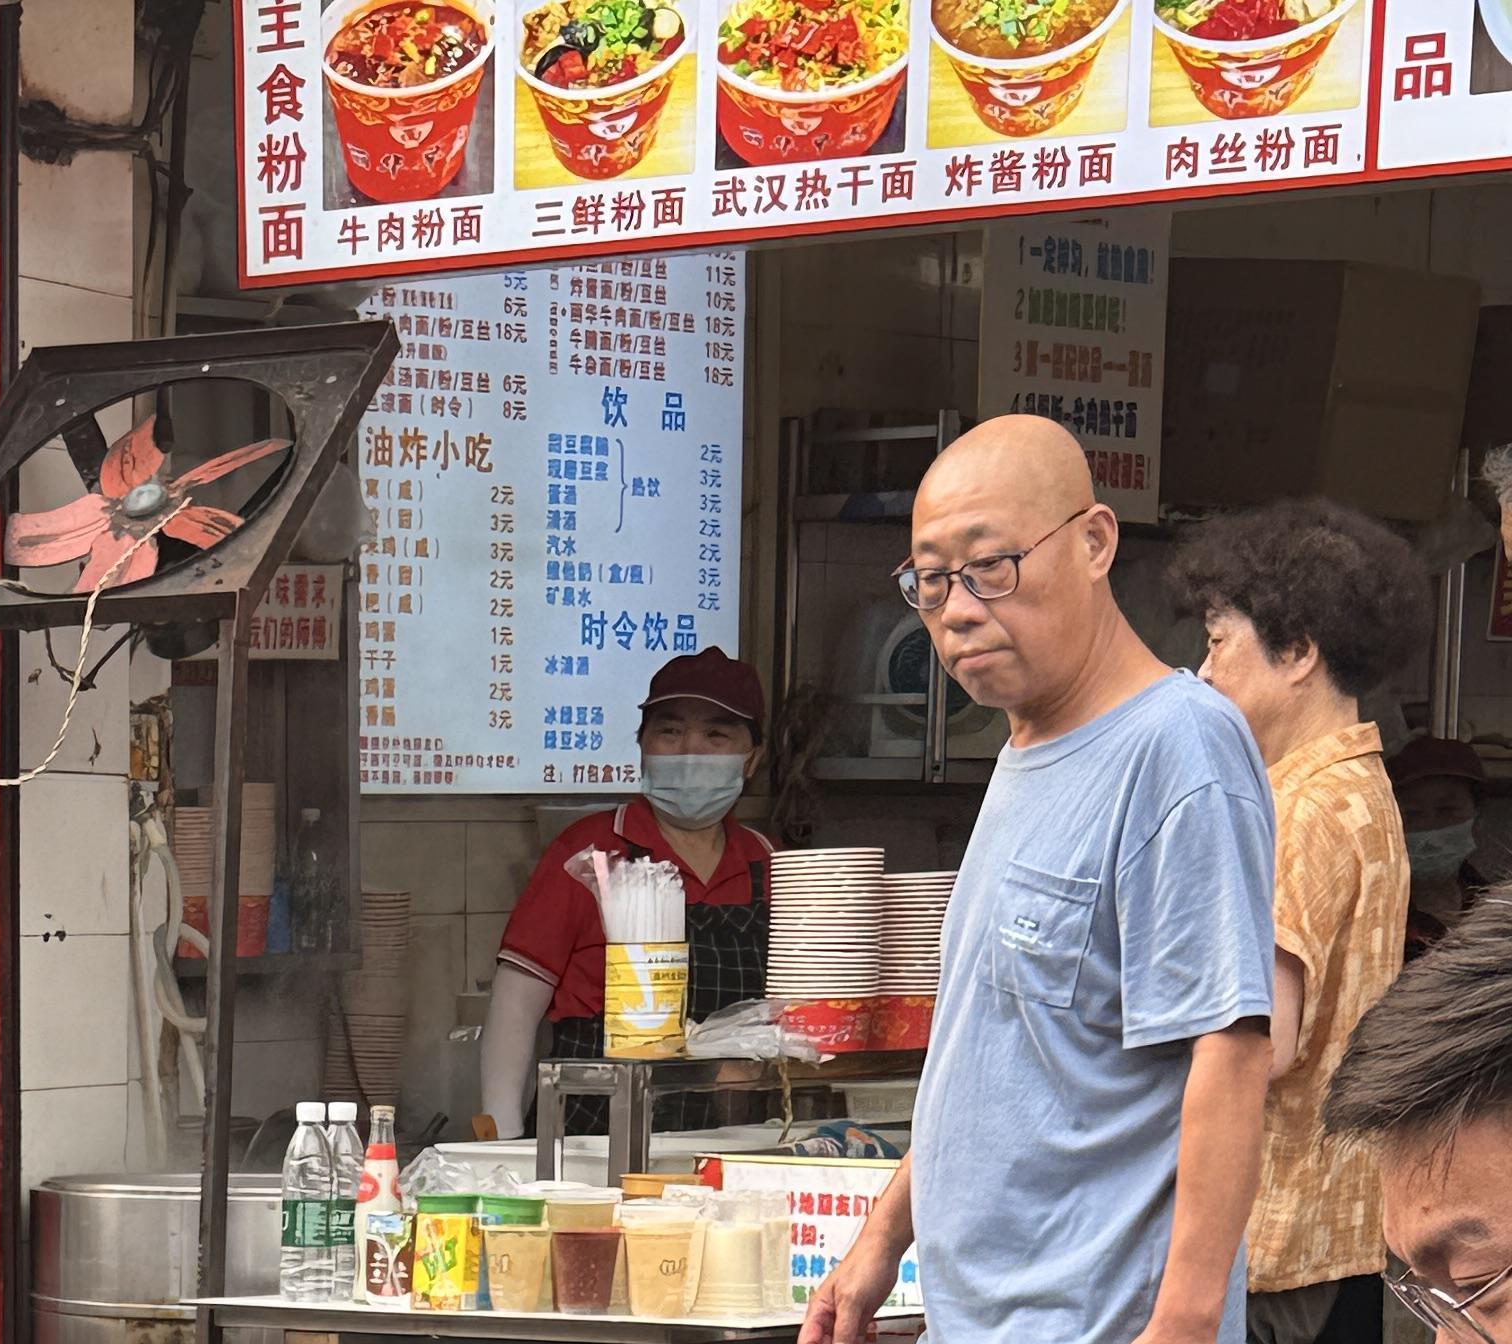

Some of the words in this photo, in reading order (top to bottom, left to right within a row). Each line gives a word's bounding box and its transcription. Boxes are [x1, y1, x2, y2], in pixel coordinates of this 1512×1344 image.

[1393, 33, 1452, 101] 品
[257, 0, 306, 261] 主食粉面
[1165, 124, 1343, 180] 肉丝粉面
[712, 157, 917, 217] 武汉热干面
[945, 143, 1116, 198] 炸酱粉面
[337, 205, 484, 256] 牛肉粉面
[532, 186, 686, 238] 三鲜粉面
[365, 426, 493, 472] 油炸小吃
[581, 610, 697, 652] 时令饮品
